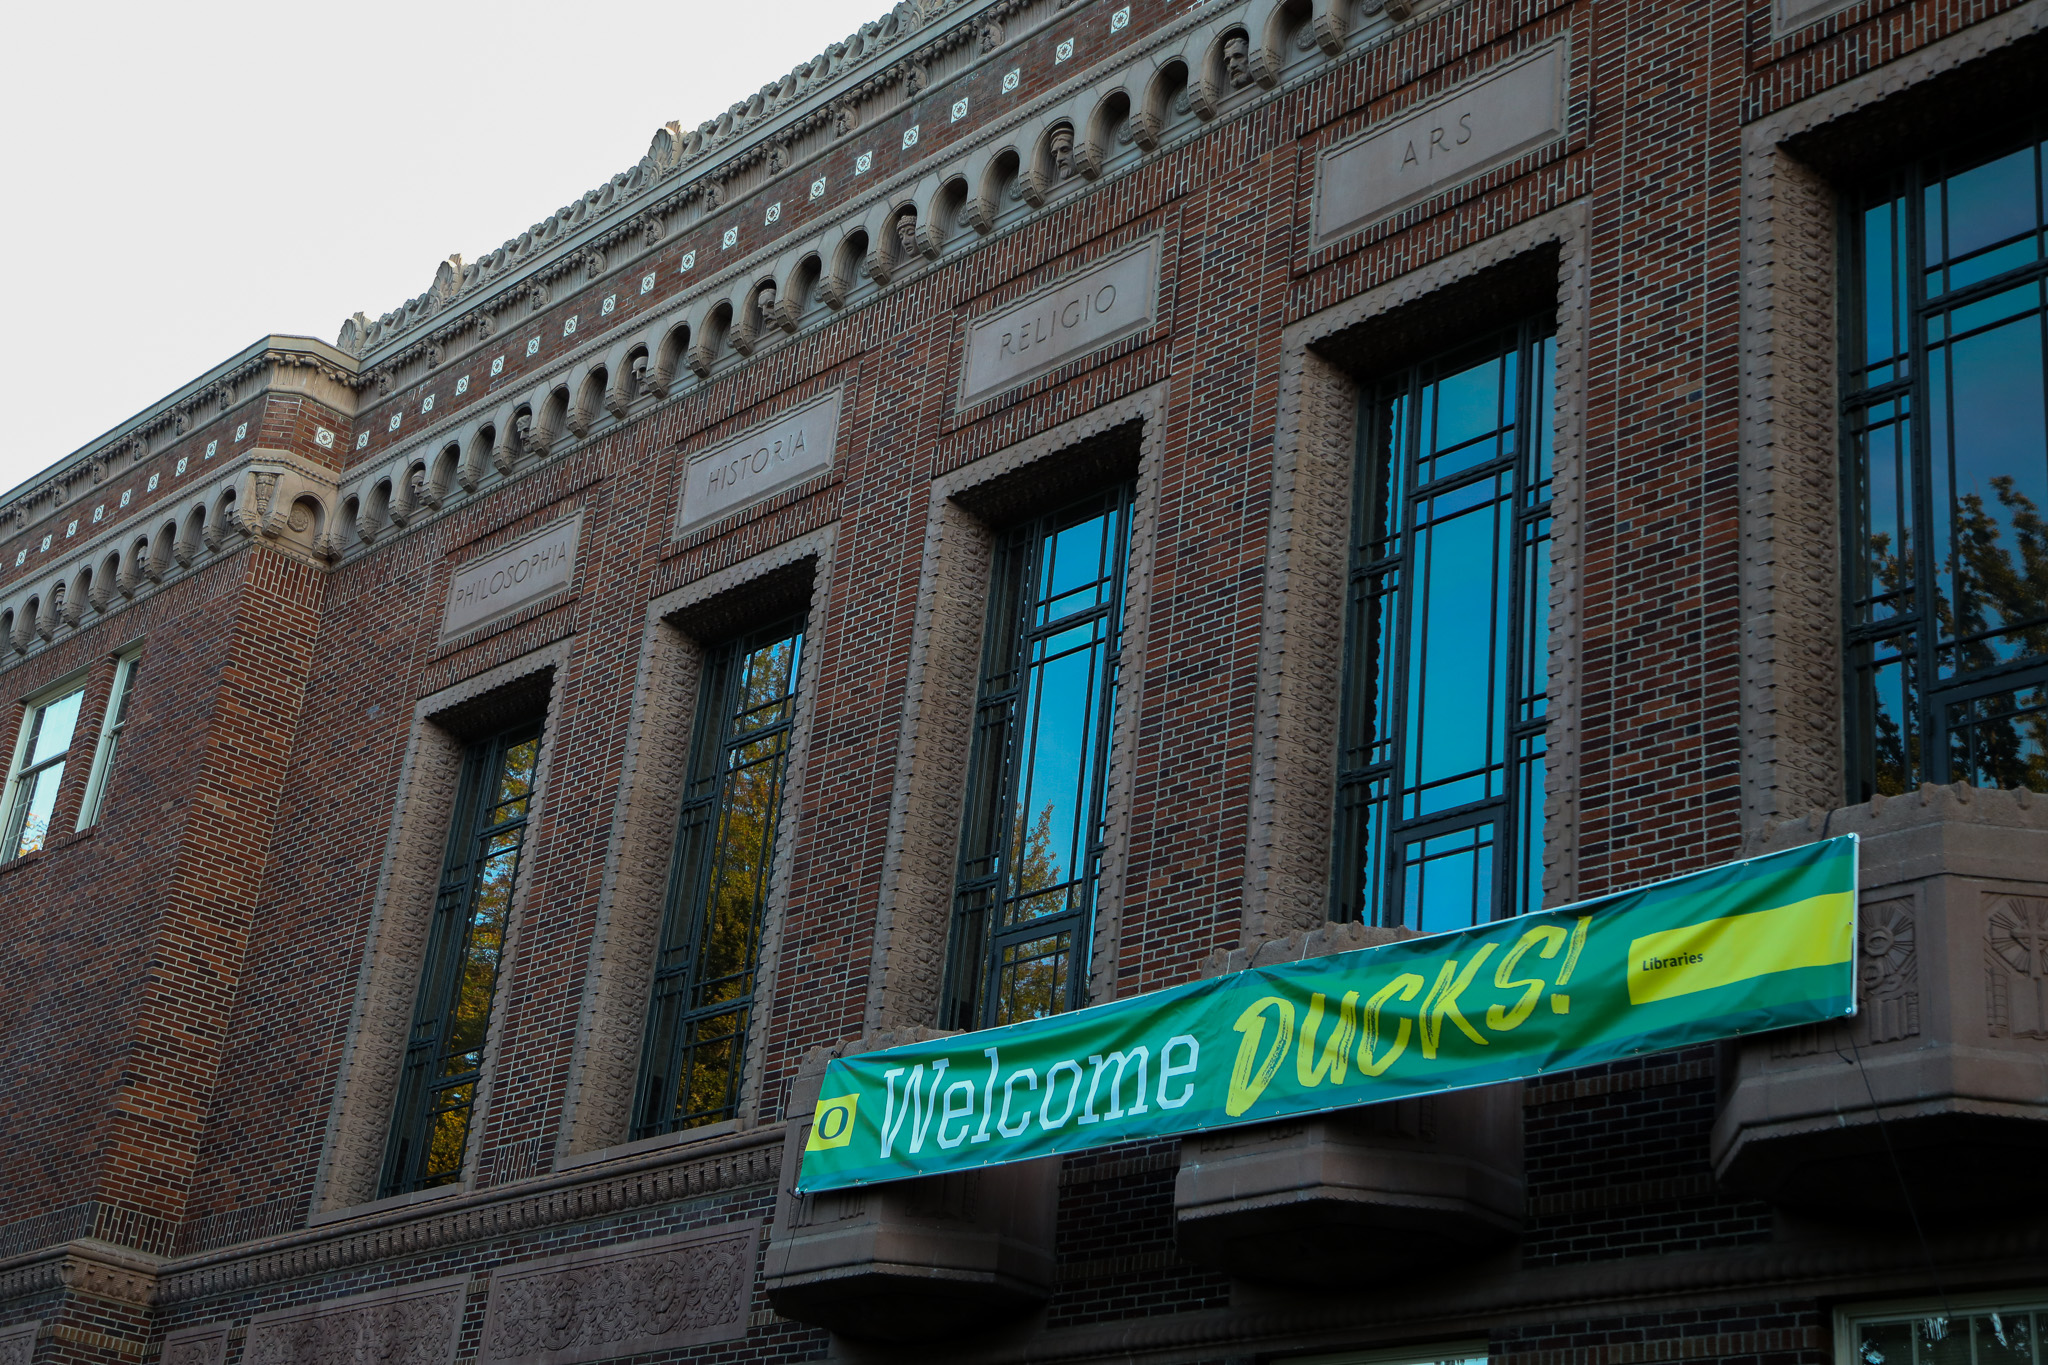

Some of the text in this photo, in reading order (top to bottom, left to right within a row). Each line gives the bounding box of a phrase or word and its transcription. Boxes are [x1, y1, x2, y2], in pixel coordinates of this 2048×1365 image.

[1400, 112, 1472, 173] ARS
[1000, 284, 1116, 360] RELIGIO
[707, 430, 805, 496] HISTORIA
[454, 541, 567, 612] PHILOSOPHIA
[1642, 952, 1704, 971] Libraries
[880, 916, 1593, 1159] Welcome DUCKS!
